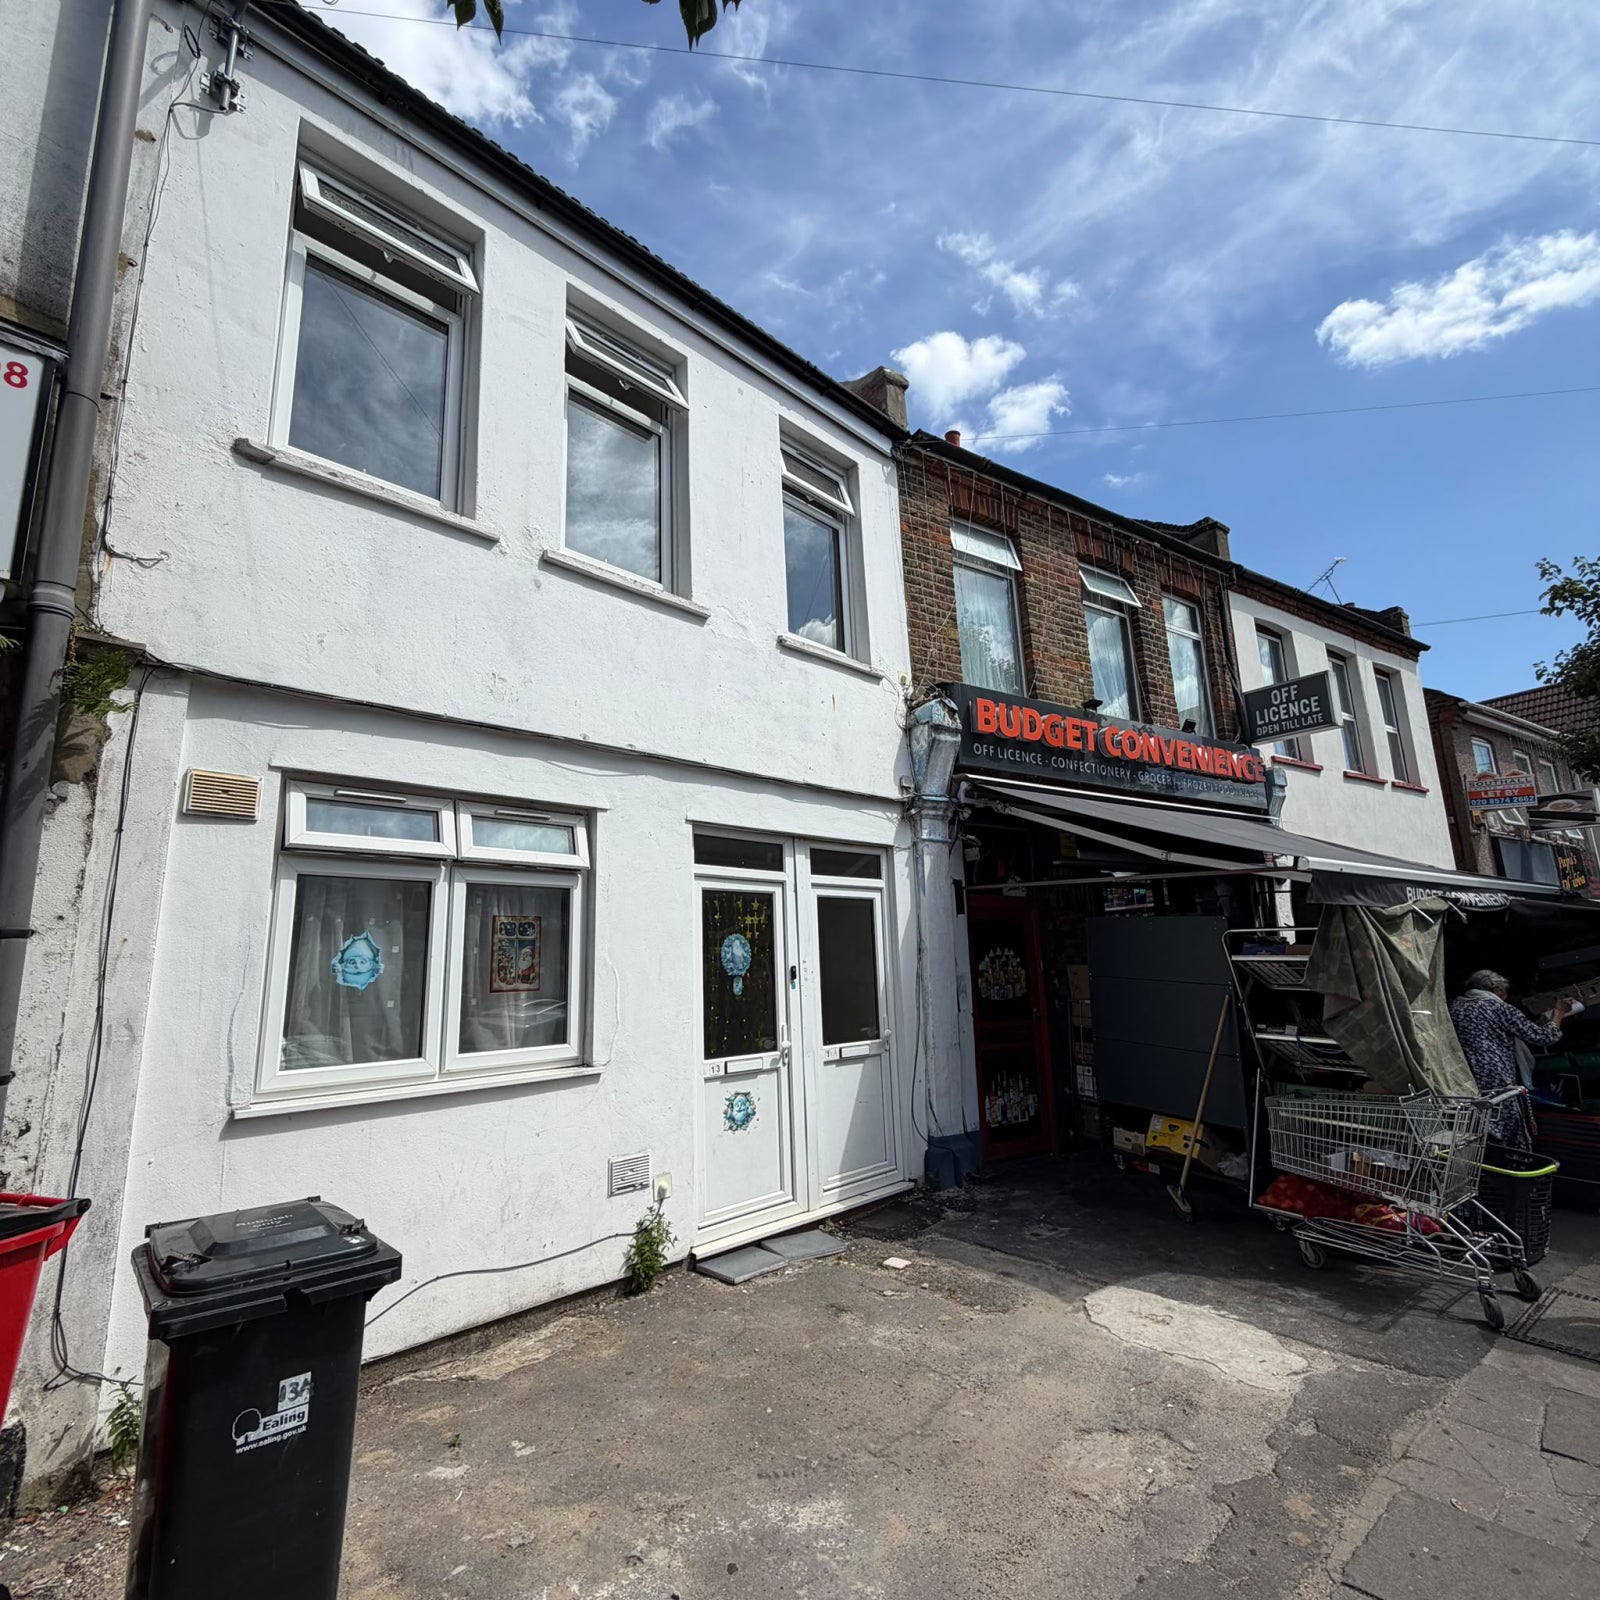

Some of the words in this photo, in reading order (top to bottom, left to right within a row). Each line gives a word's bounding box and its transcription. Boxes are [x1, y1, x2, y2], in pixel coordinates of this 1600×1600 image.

[0, 361, 29, 389] 8
[1270, 684, 1298, 705] OFF
[1256, 695, 1320, 725] LICENCE
[1256, 722, 1280, 737] OPEN
[1281, 718, 1300, 731] TILL
[1301, 712, 1324, 726] LATE
[974, 697, 1099, 753] BUDGET
[1103, 725, 1267, 783] CONVENIENCE
[973, 742, 995, 757] OFF
[997, 747, 1043, 765] LICENCE
[1051, 756, 1131, 781] CONFECTIONERY
[1138, 770, 1176, 786] GROCERY
[1481, 790, 1501, 798] LET
[711, 1065, 720, 1075] 13
[262, 1410, 306, 1431] Ealing
[235, 1424, 307, 1454] www.ealing.gov.uk
